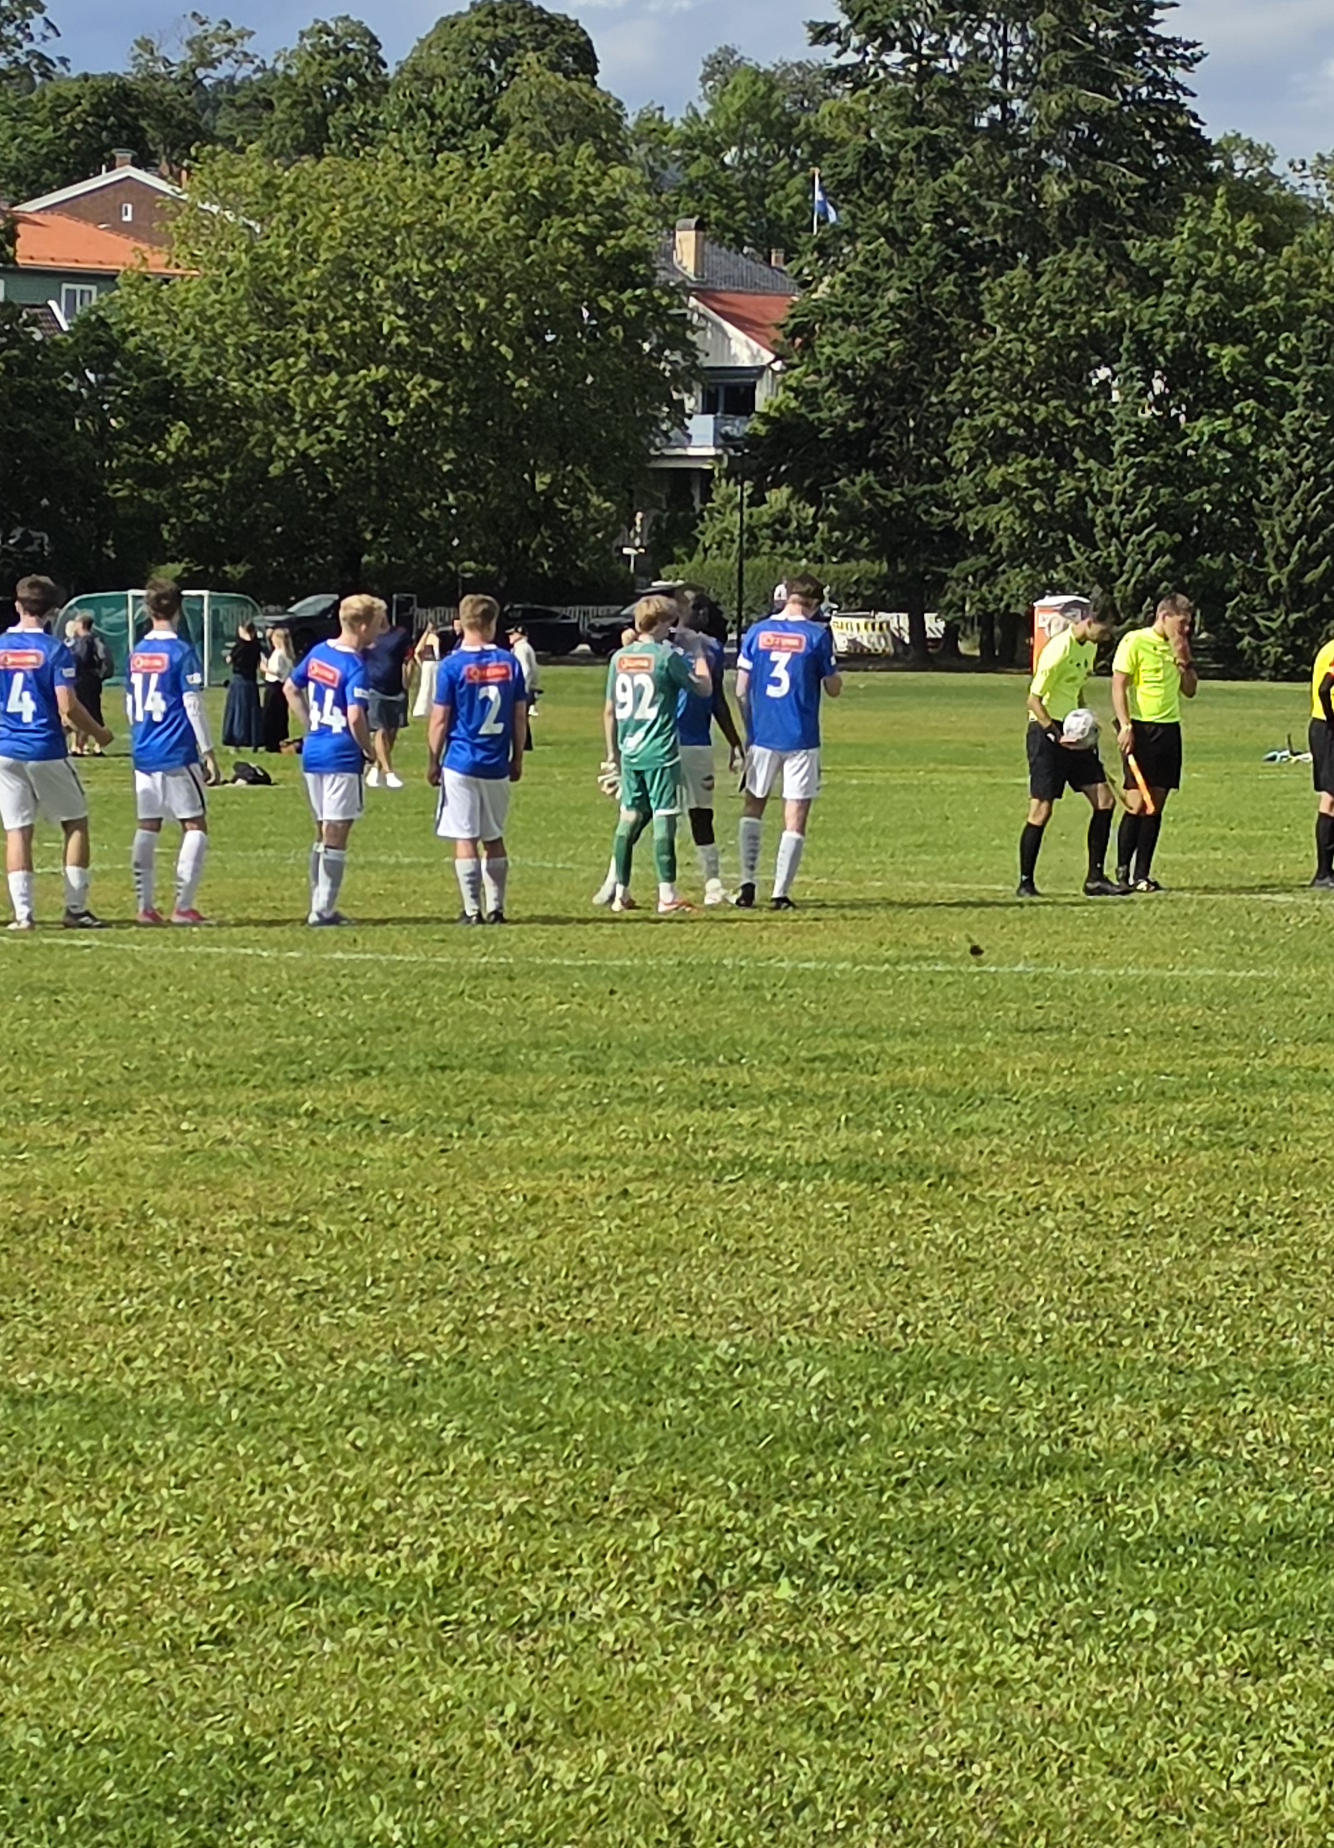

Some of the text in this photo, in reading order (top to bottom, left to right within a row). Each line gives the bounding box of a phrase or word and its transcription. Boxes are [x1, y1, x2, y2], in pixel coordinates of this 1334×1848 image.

[6, 672, 37, 723] 4
[130, 673, 166, 722] 14
[615, 673, 658, 720] 92
[766, 652, 791, 698] 3
[308, 681, 347, 734] 44
[478, 685, 505, 735] 2
